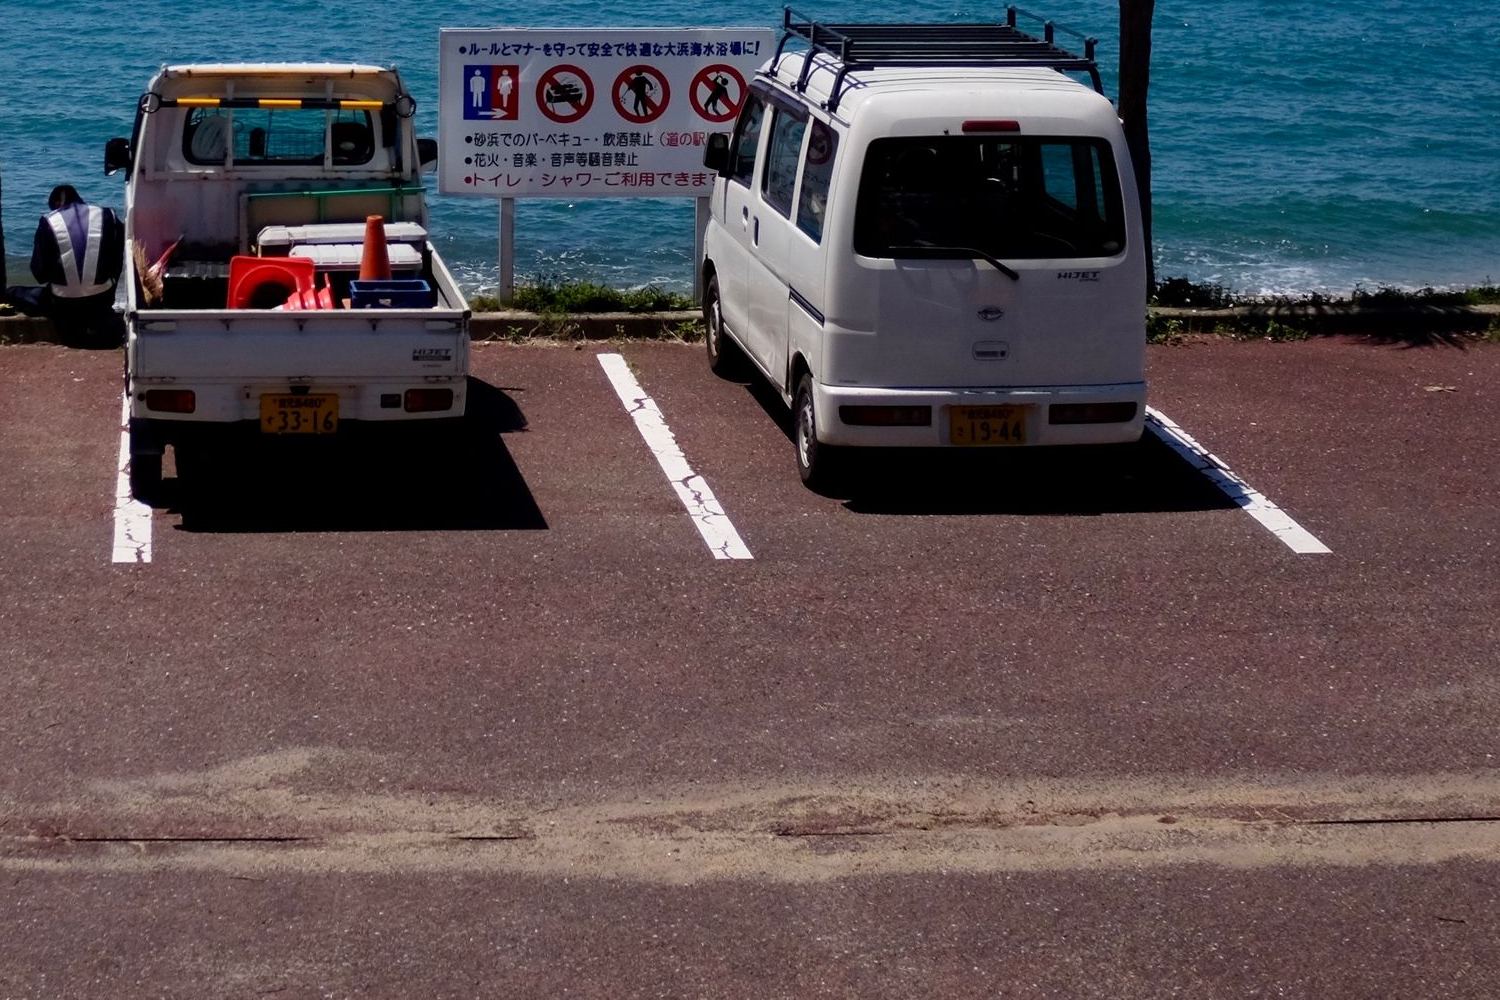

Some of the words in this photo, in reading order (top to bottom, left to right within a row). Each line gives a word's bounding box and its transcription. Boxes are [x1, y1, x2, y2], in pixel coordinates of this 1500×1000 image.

[1057, 271, 1101, 279] HIJET
[278, 410, 334, 430] 33-16
[971, 422, 1022, 441] 19-44
